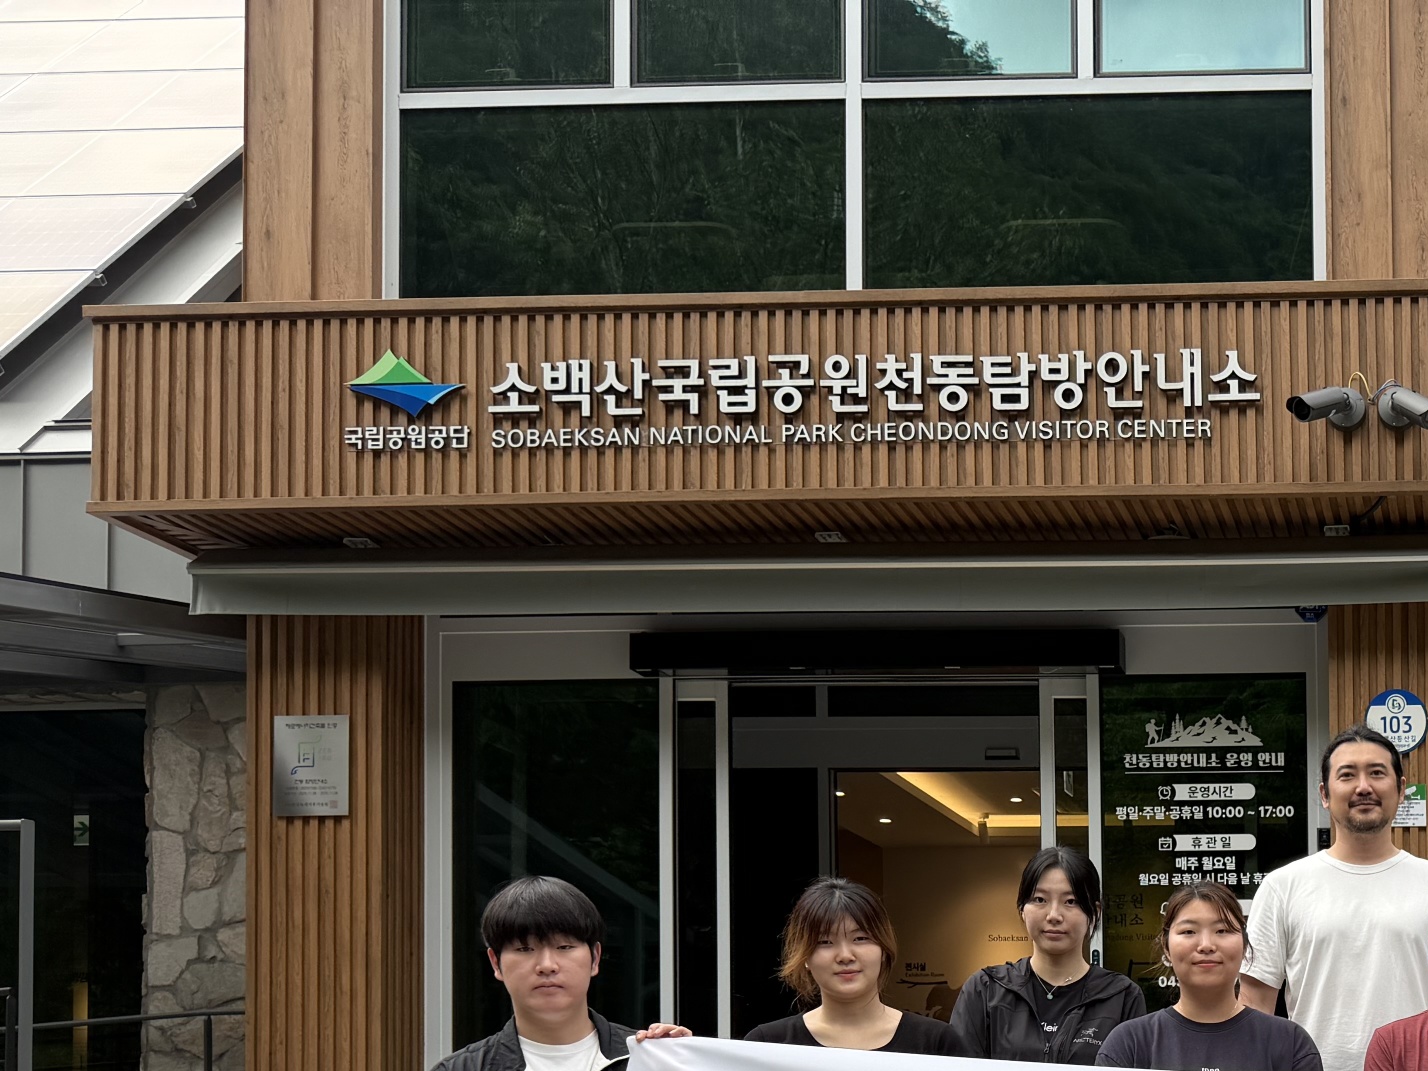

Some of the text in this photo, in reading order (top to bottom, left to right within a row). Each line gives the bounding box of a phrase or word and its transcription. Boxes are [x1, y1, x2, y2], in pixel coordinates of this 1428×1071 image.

[487, 348, 1262, 417] 소백산국립공원천동탐방안내소
[343, 425, 470, 450] 국립공원공단
[491, 418, 1212, 449] SOBAEKSAN NATIONAL PARK CHEONDONG VISITOR CENTER
[1380, 715, 1413, 734] 103
[1123, 752, 1285, 769] 천동탐방안내소 운영 안내
[1187, 785, 1234, 799] 운영시간
[1206, 806, 1245, 819] 10:00
[1258, 805, 1295, 818] 17:00
[1175, 856, 1236, 871] 매주 월요일
[1138, 873, 1169, 886] 월요일
[1217, 872, 1238, 885] 다음
[1240, 872, 1251, 885] 날
